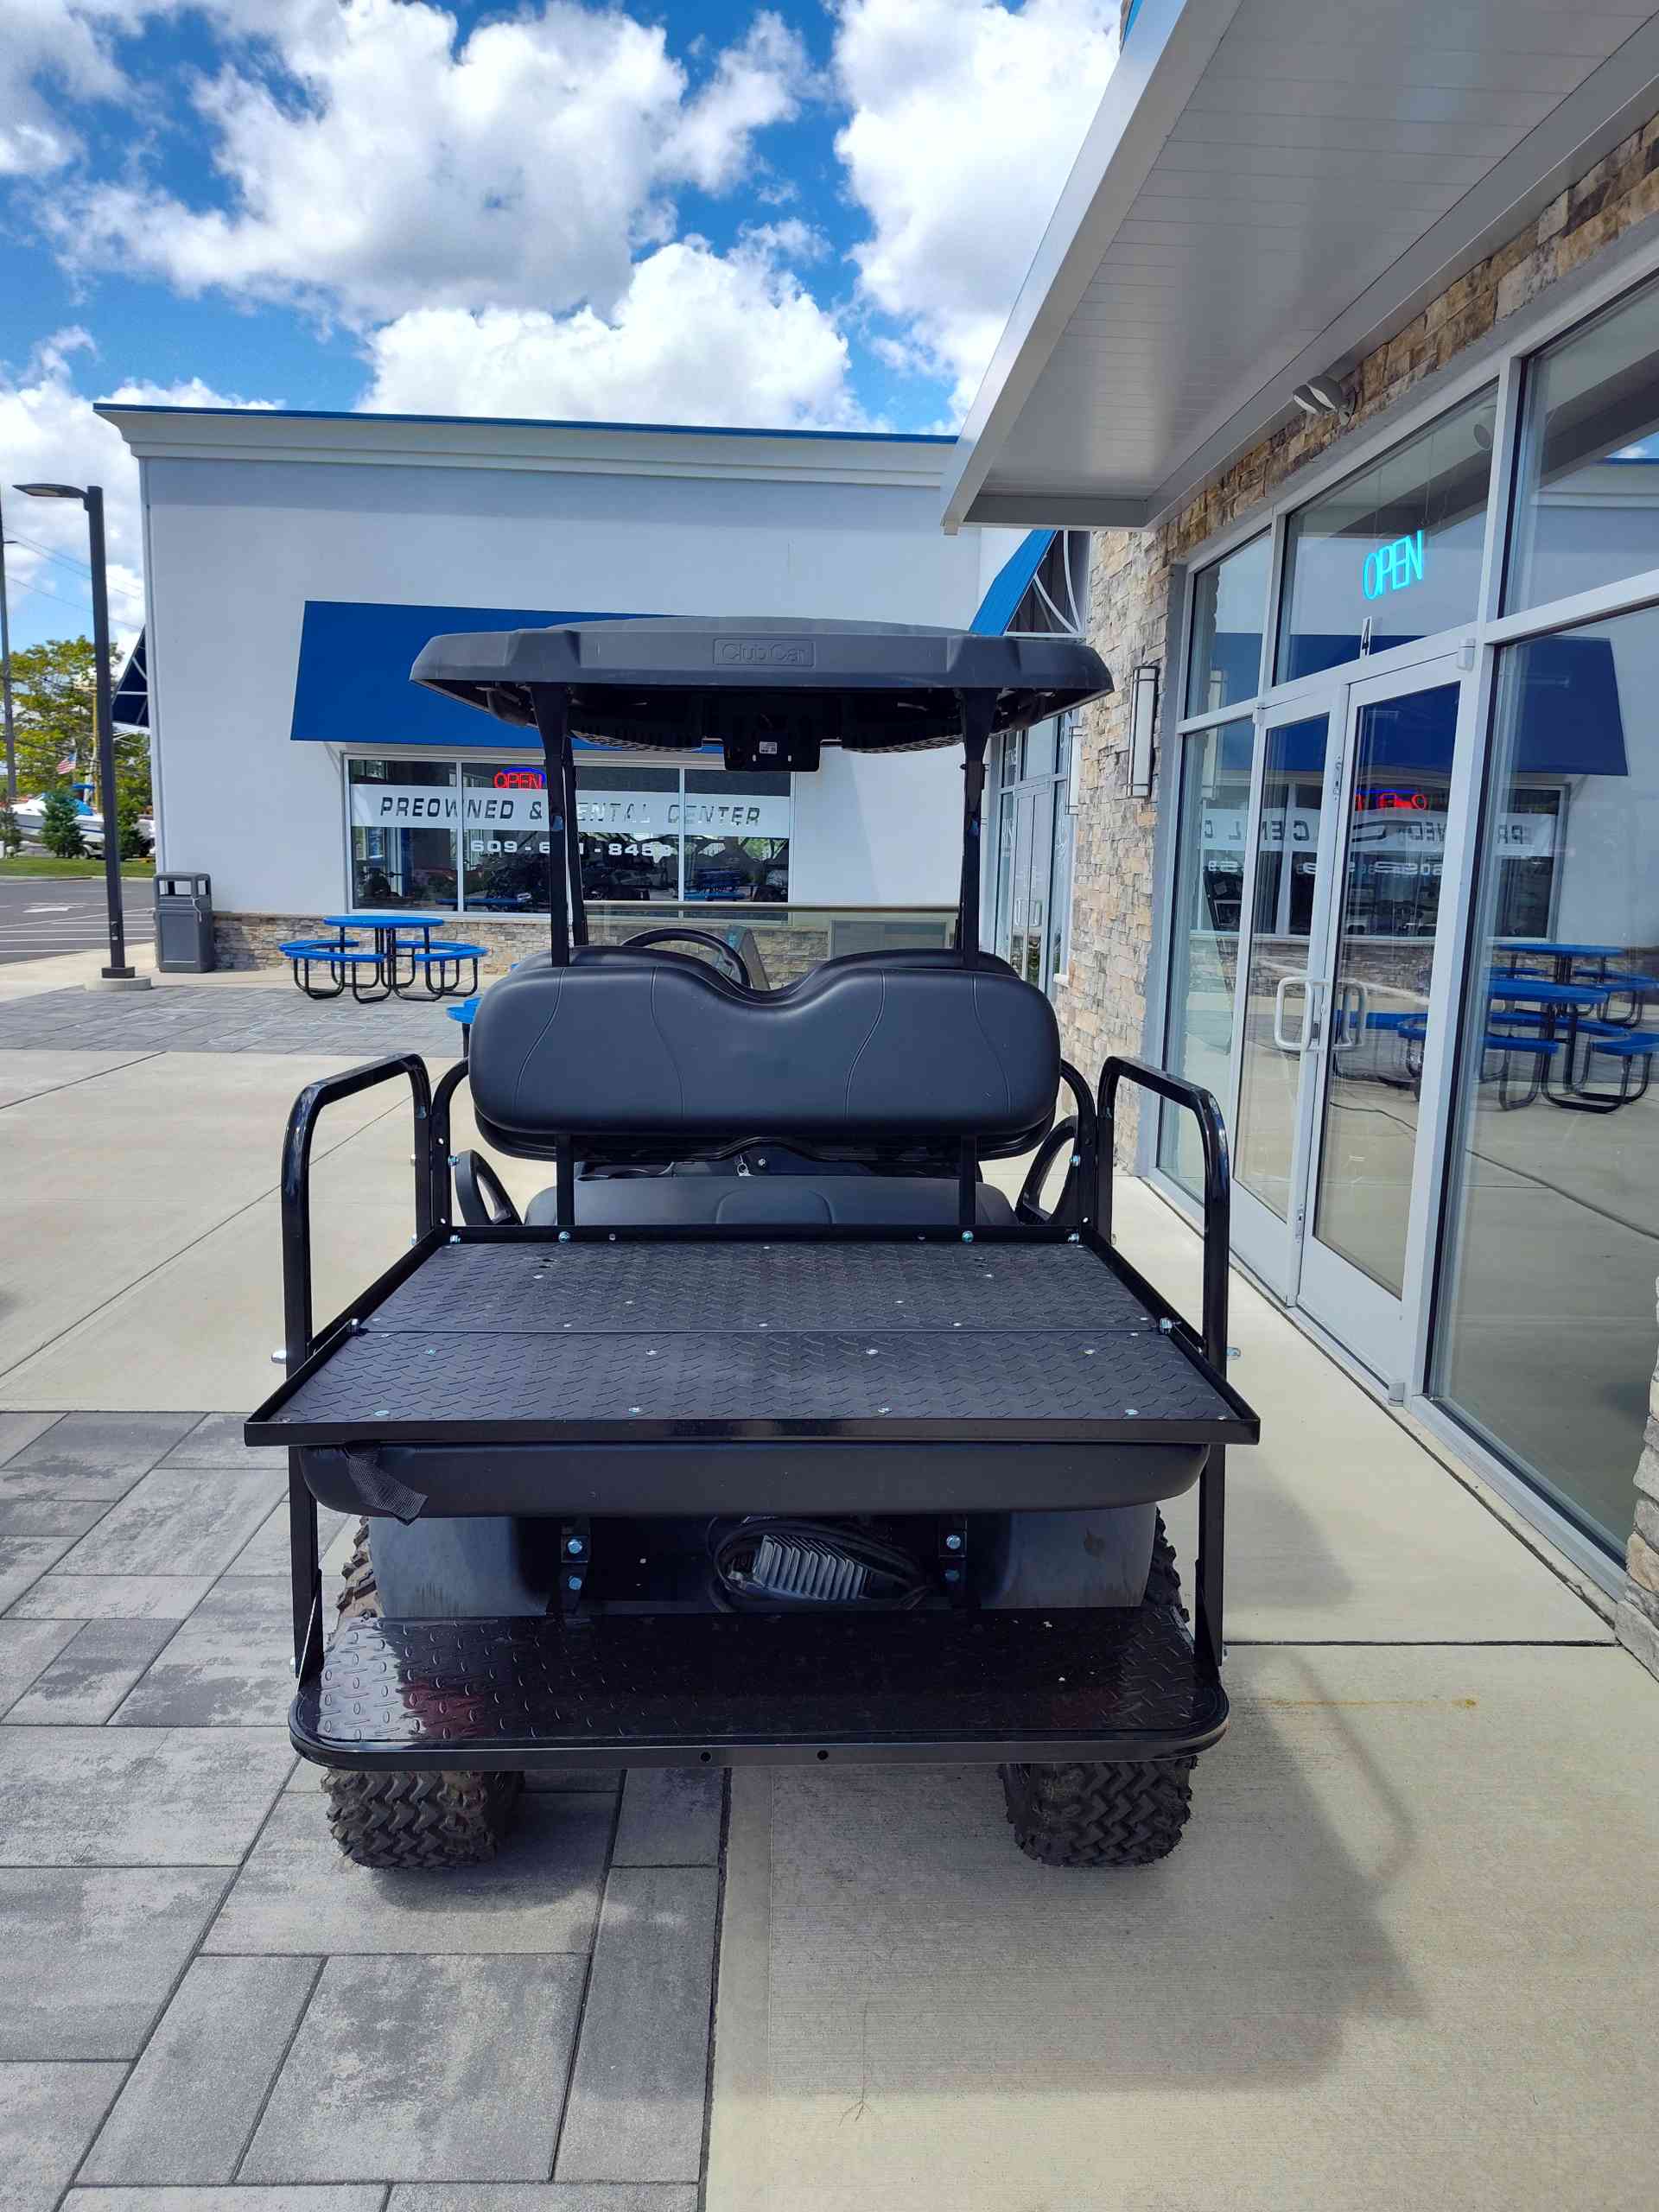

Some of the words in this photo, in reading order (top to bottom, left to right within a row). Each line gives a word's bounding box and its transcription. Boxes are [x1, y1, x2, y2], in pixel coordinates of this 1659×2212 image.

[1363, 530, 1424, 600] OPEN
[722, 643, 766, 661] Club
[770, 644, 806, 664] Car
[493, 772, 543, 789] OPEN
[380, 797, 514, 819] PREOWNED
[530, 801, 543, 820] &
[576, 802, 650, 823] ENTAL
[667, 804, 760, 826] CENTER
